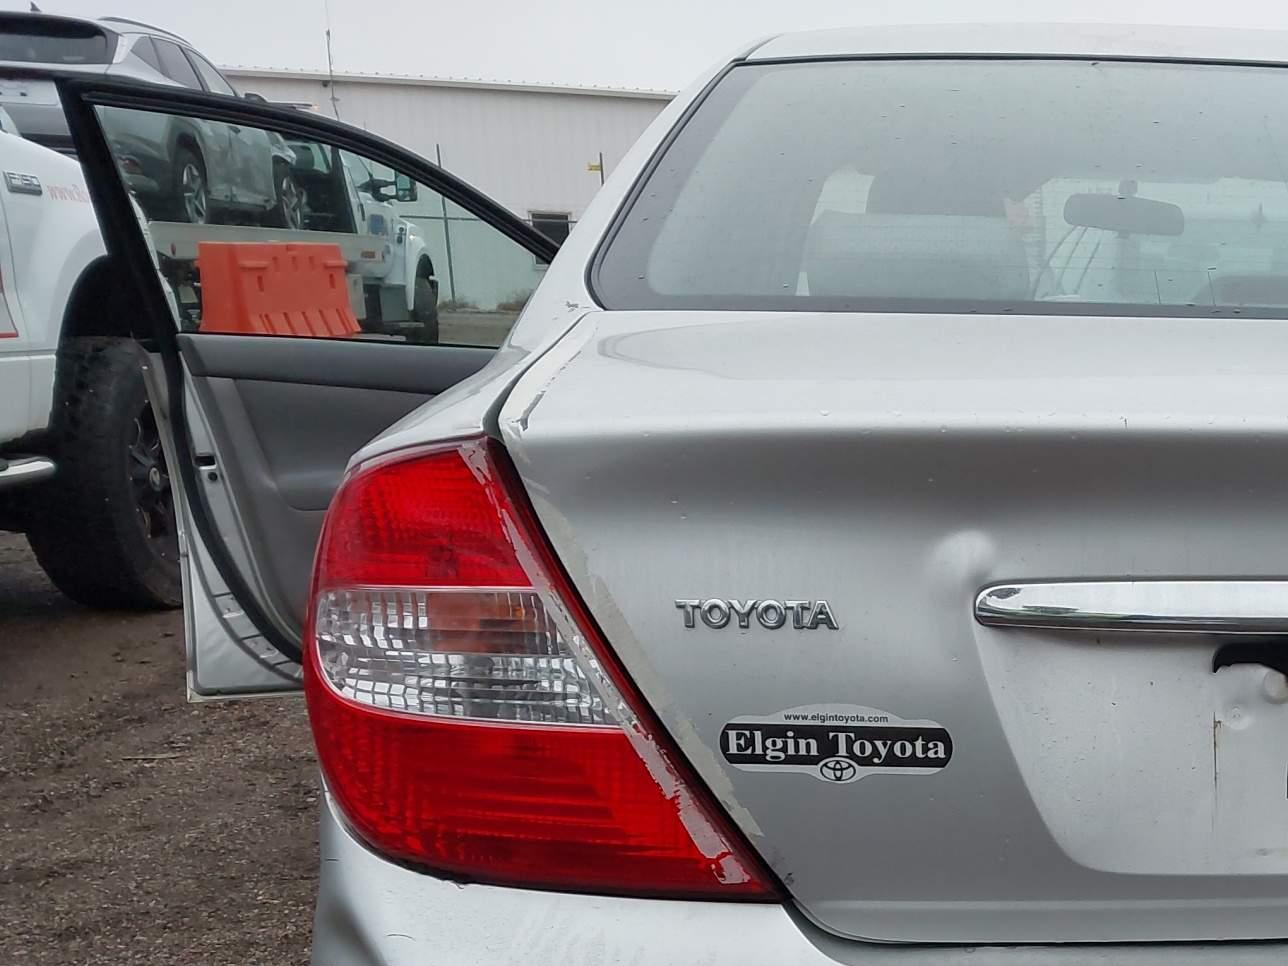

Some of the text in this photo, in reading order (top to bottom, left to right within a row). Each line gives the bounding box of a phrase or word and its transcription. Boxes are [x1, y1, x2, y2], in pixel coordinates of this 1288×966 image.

[675, 598, 840, 630] TOYOTA
[783, 712, 889, 724] www.elgintoyota.com
[724, 729, 947, 764] Elgin Toyota
